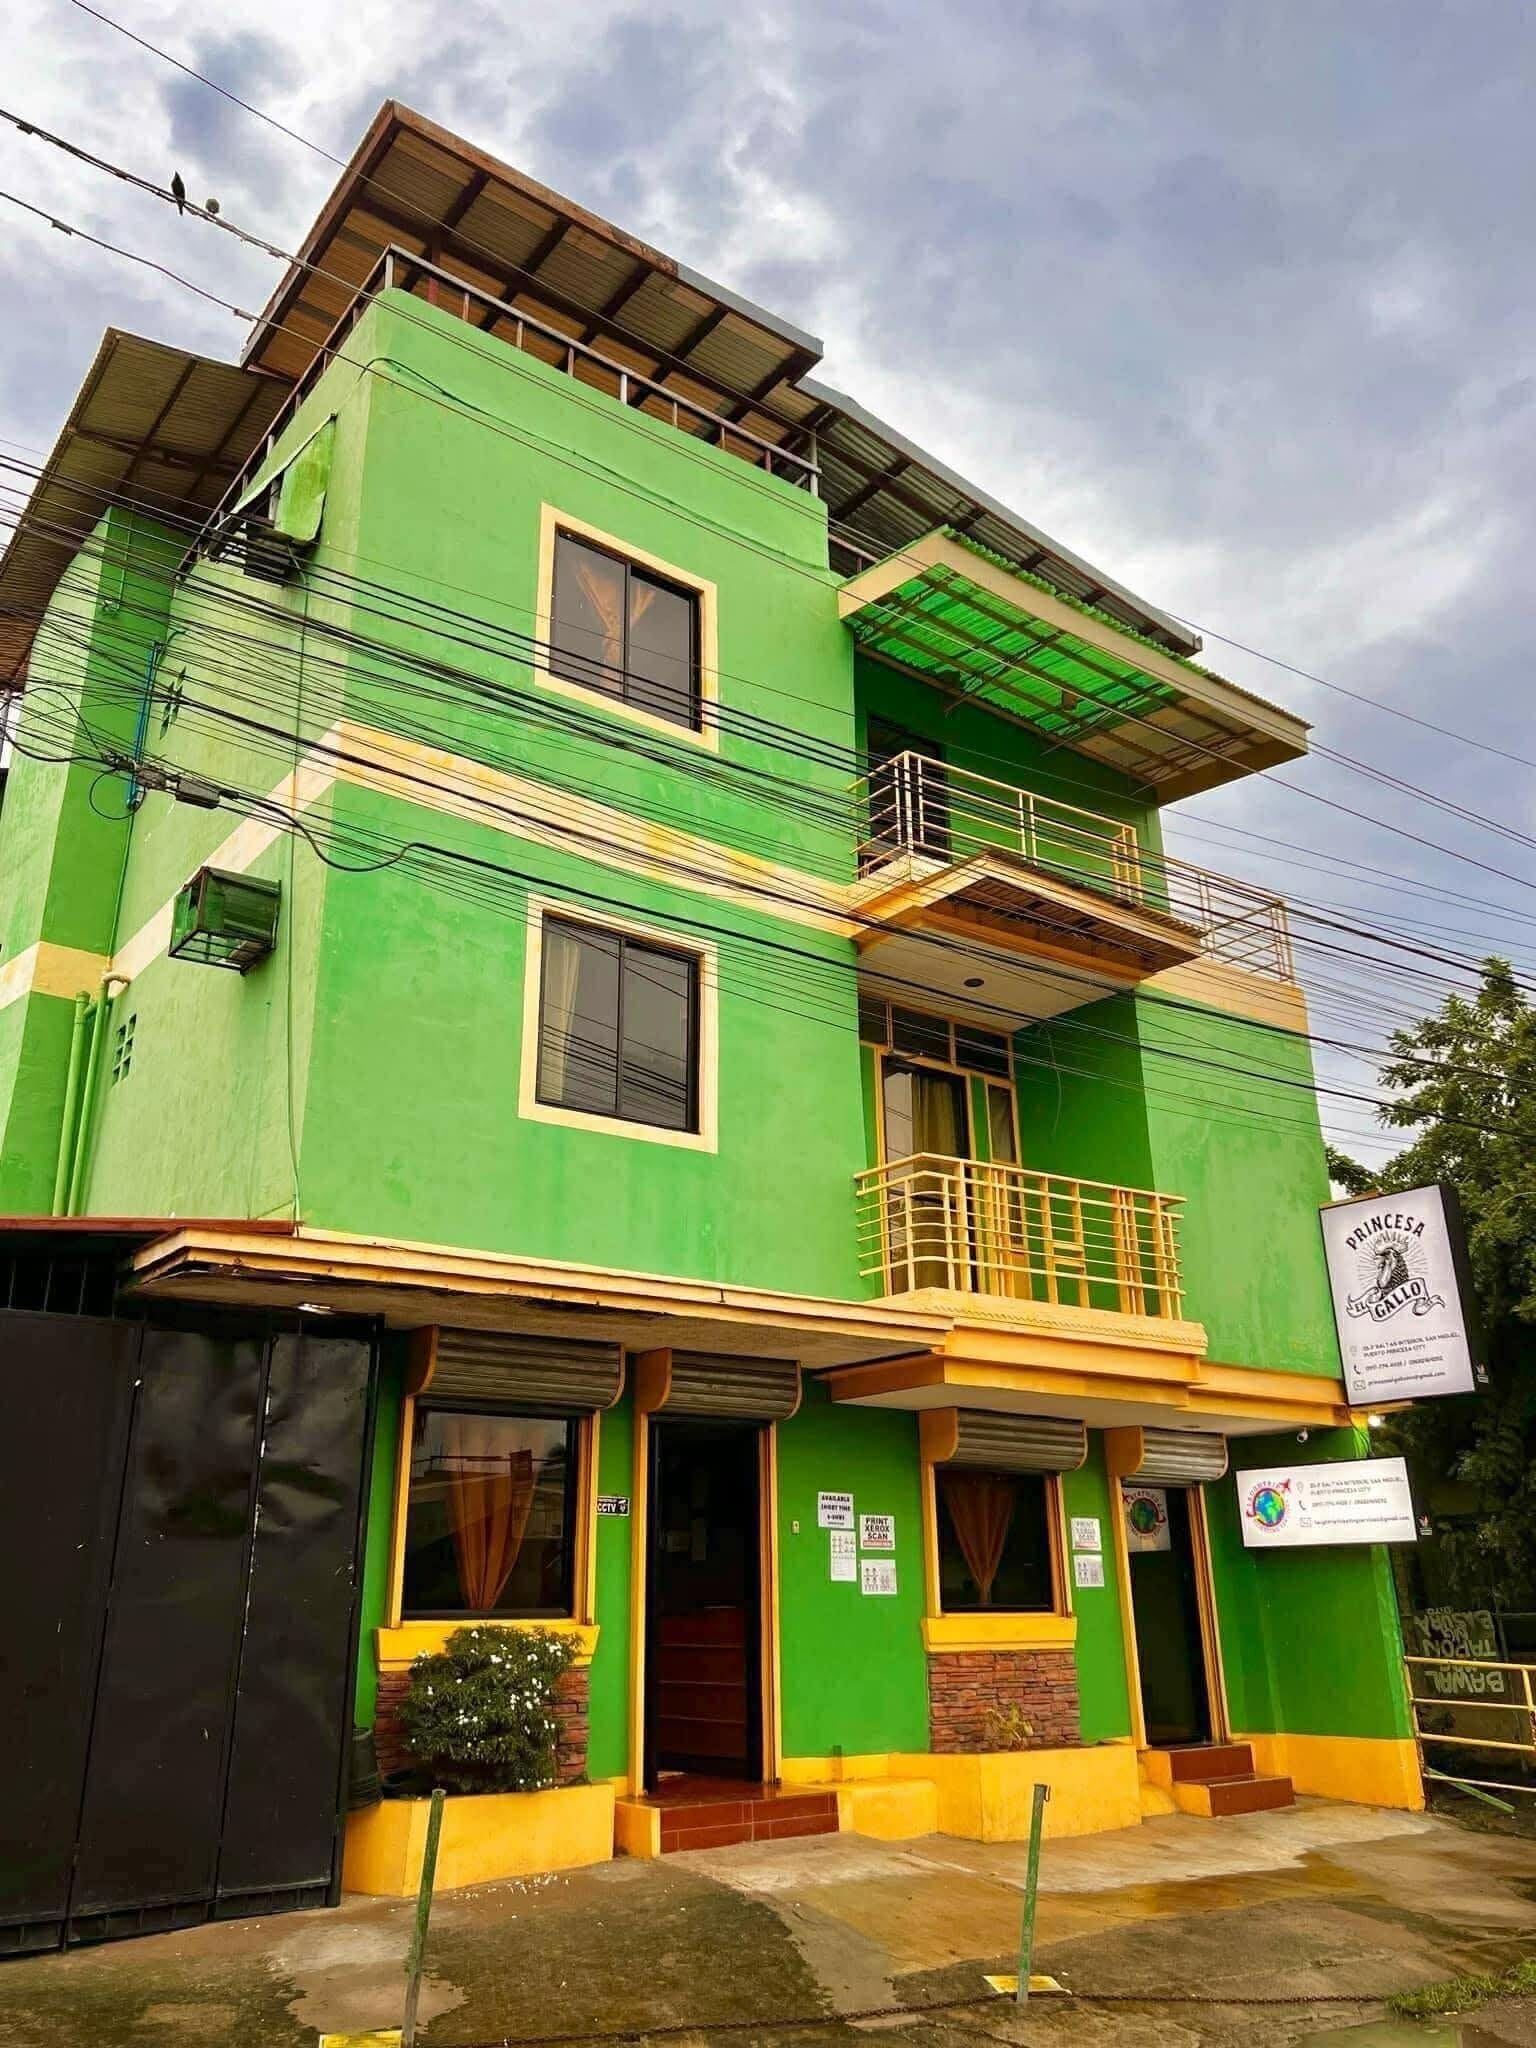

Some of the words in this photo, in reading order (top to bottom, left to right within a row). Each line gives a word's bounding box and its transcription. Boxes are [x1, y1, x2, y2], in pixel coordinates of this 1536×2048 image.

[1345, 1213, 1425, 1250] PRINCESA
[1374, 1281, 1421, 1318] GALLO
[1354, 1302, 1366, 1312] EL
[1413, 1343, 1426, 1351] CITY
[821, 1494, 850, 1502] AVAILABLE
[597, 1503, 617, 1512] CCTV
[865, 1517, 889, 1525] PRINT
[867, 1532, 888, 1540] SCAN
[1422, 1639, 1497, 1658] TAPON
[1423, 1670, 1505, 1694] BAWAL
